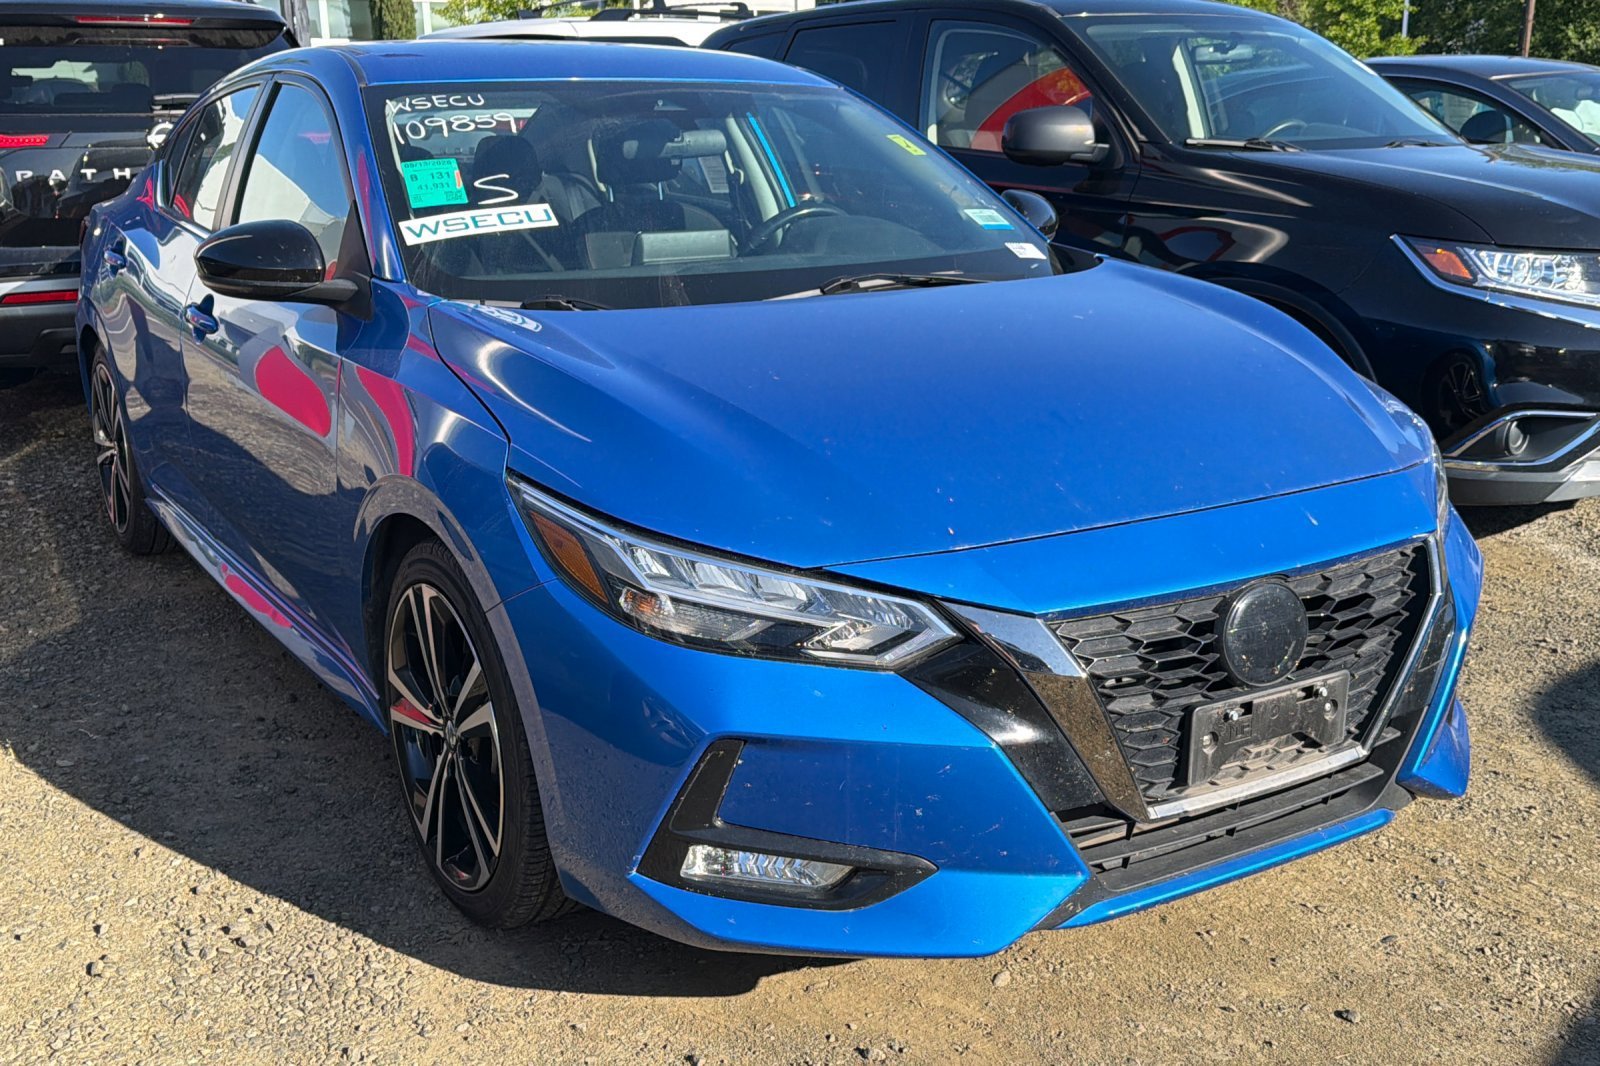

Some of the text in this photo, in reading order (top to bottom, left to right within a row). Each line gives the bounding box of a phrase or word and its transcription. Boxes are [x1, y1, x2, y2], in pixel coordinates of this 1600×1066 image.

[386, 93, 485, 113] WSECU
[393, 112, 518, 145] 109859
[15, 167, 131, 182] PATH
[430, 171, 451, 180] 131
[405, 208, 553, 238] WSECU
